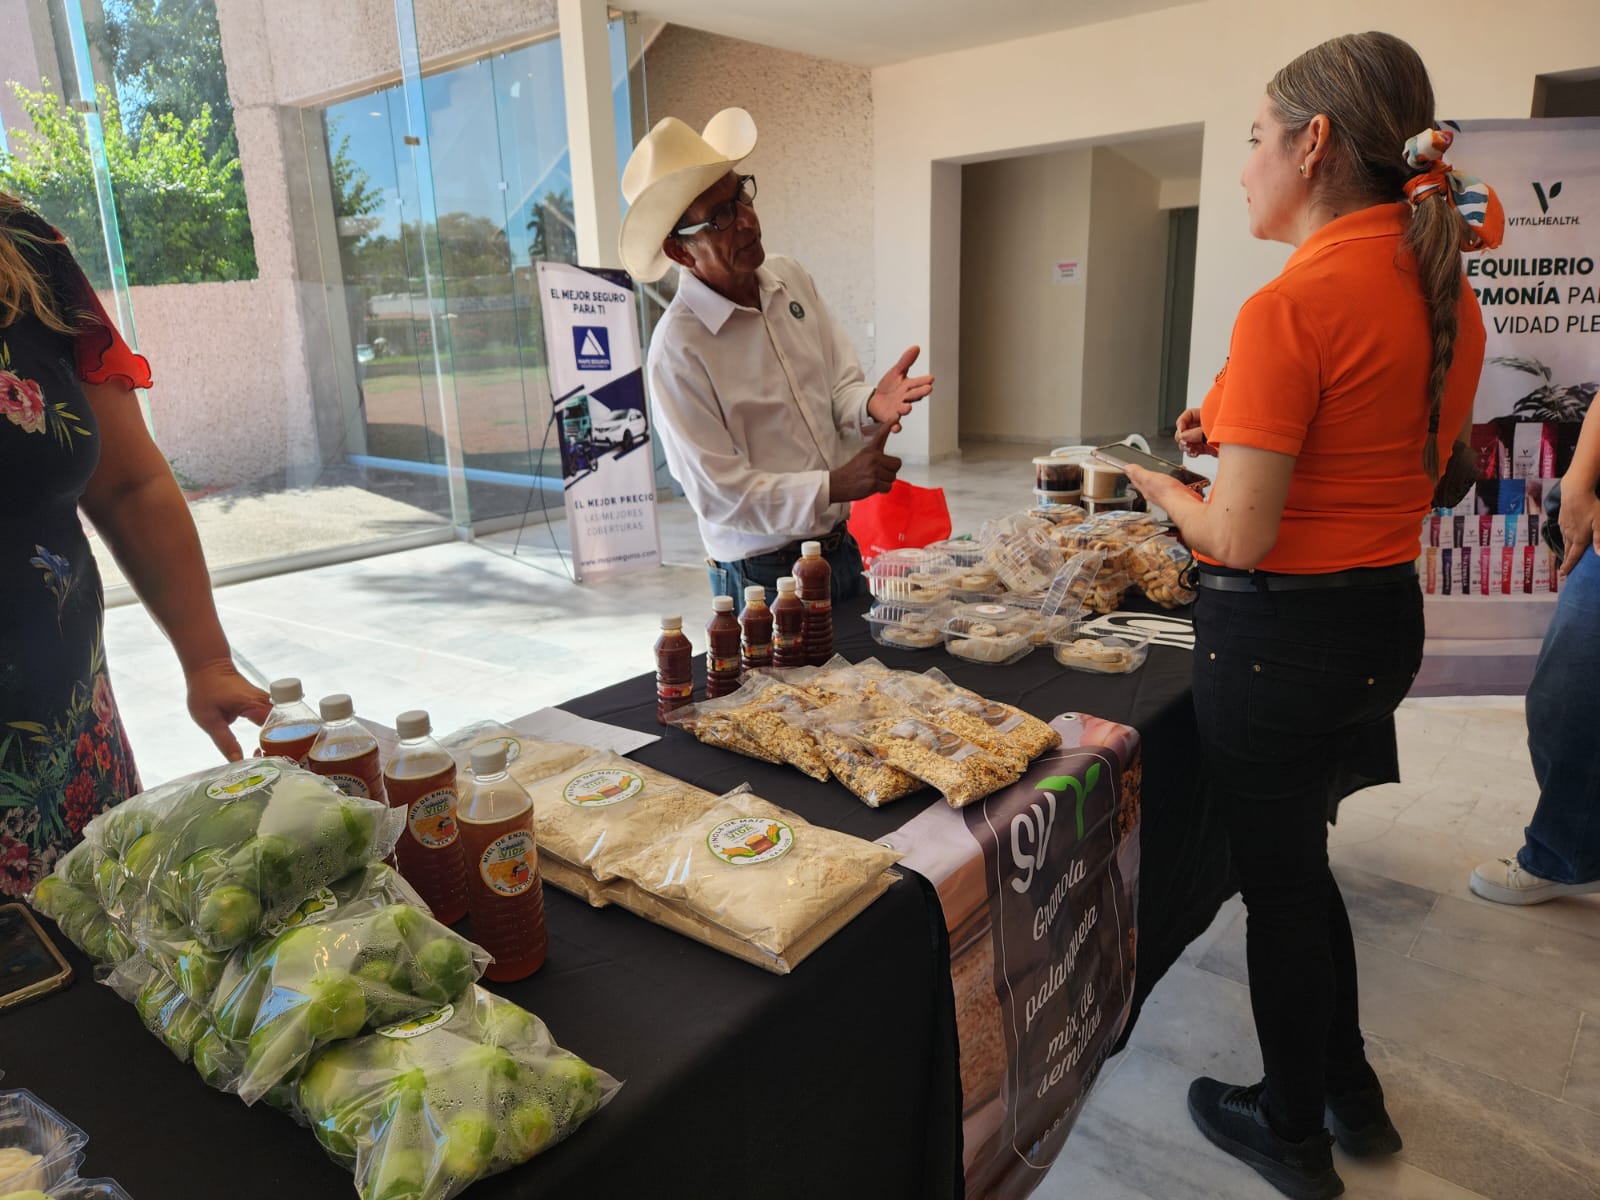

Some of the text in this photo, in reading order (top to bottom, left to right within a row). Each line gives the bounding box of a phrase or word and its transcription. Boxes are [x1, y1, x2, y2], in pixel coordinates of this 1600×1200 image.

[1466, 257, 1594, 279] EQUILIBRIO
[550, 288, 627, 303] EL MEJOR SEGURO
[1473, 281, 1560, 305] MONÍA
[573, 303, 606, 315] PARA TI
[1493, 316, 1560, 334] VIDAD
[575, 493, 654, 509] EL MEJOR PRECIO
[601, 509, 643, 521] MEJORES
[587, 521, 643, 536] COBERTURAS
[424, 802, 450, 816] VIDA
[483, 847, 496, 863] MIEL
[495, 838, 506, 847] DE
[498, 846, 526, 859] VIDA
[1033, 859, 1087, 941] Granola
[1025, 905, 1099, 1033] palanqueta
[1046, 981, 1095, 1063] mix de
[1036, 1004, 1102, 1098] semillas
